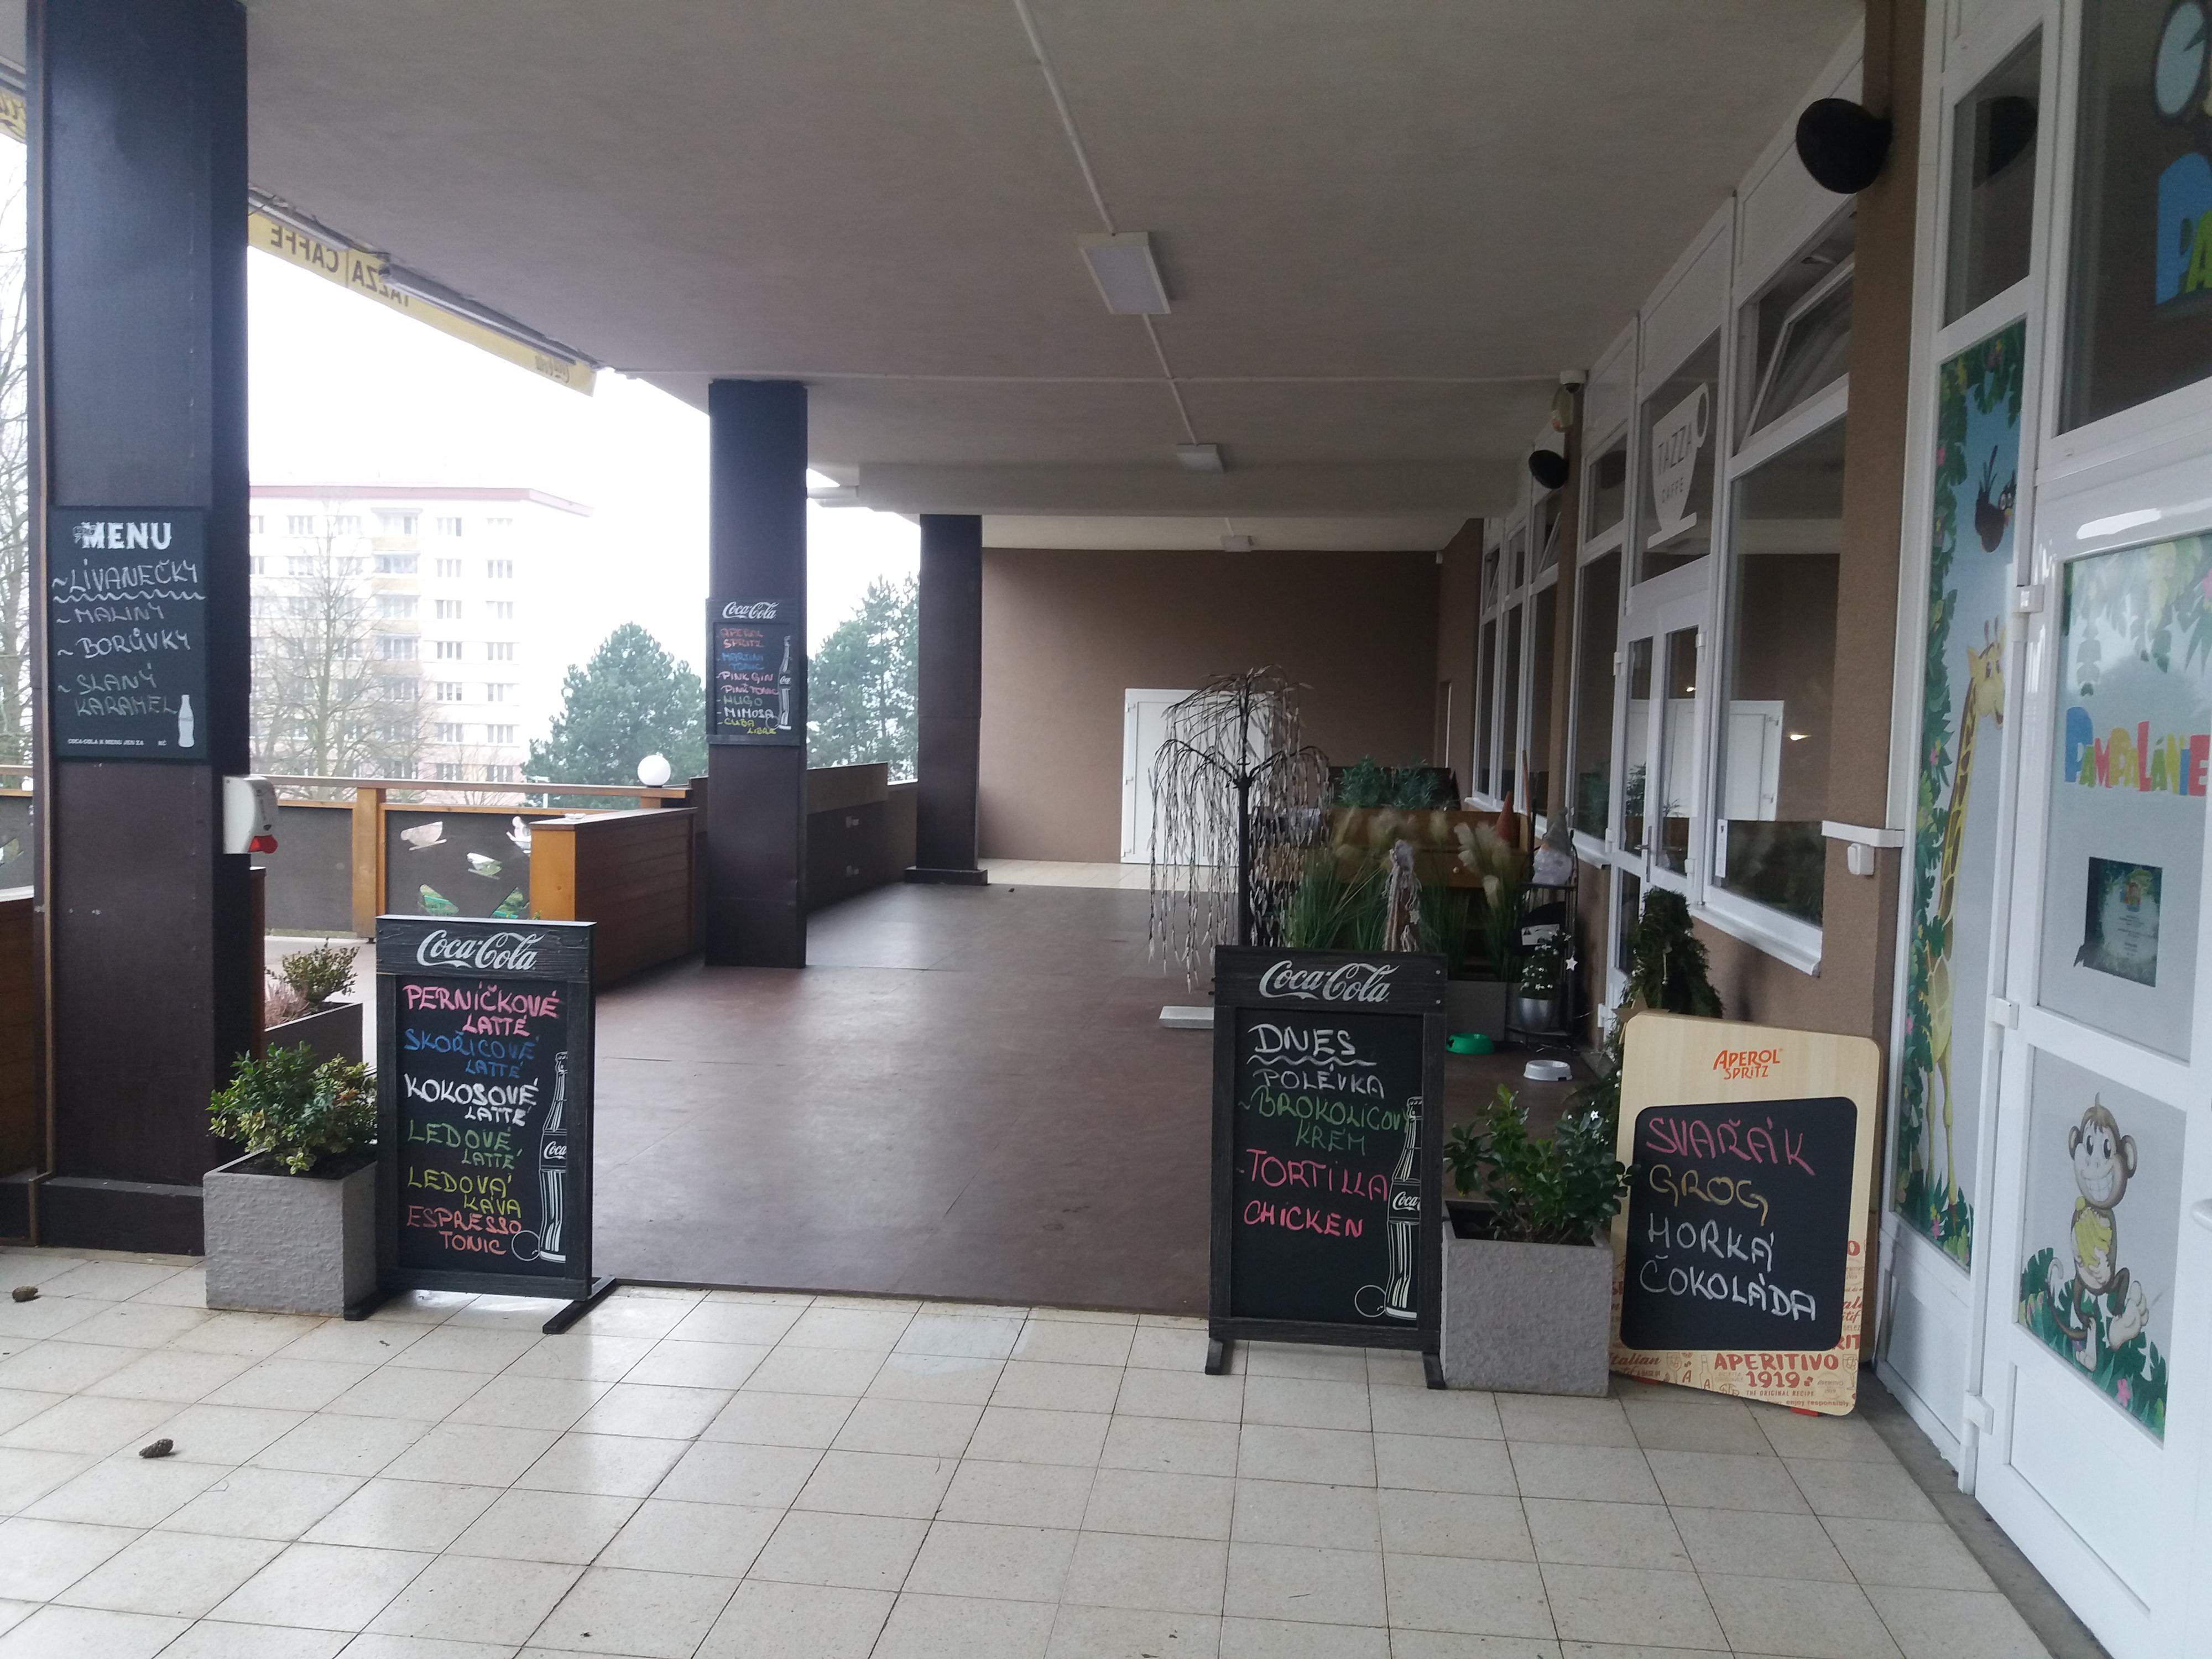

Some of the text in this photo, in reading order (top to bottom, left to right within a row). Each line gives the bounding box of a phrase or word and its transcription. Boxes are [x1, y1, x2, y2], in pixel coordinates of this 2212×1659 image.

[1658, 421, 1693, 476] TAZZA
[81, 522, 172, 550] MENU
[69, 558, 198, 592] LÍVANEČKY
[74, 602, 165, 624] MALINY
[76, 628, 191, 659] BORŮVKY
[76, 663, 157, 695] SLANÝ
[718, 671, 773, 684] PINK GIN
[75, 695, 178, 717] KARAMEL
[723, 695, 763, 707] HUGO
[723, 707, 774, 718] MIMOSA
[723, 718, 755, 728] CUBA
[1247, 1024, 1355, 1057] DNES
[1713, 1049, 1780, 1071] APEROL
[1253, 1063, 1385, 1099] POLÉVKA
[1646, 1117, 1815, 1176] SVAŘÁK
[1246, 1149, 1388, 1202] TORTILLA
[1650, 1164, 1768, 1226] GROG
[406, 1205, 522, 1235] ESPRESSO
[1244, 1200, 1363, 1238] CHICKEN
[439, 1230, 507, 1255] TONIC
[1648, 1213, 1774, 1272] HORKÁ
[1640, 1255, 1815, 1321] ČOKOLÁDA
[1714, 1353, 1839, 1371] APERITIVO
[1746, 1371, 1800, 1388] 1919
